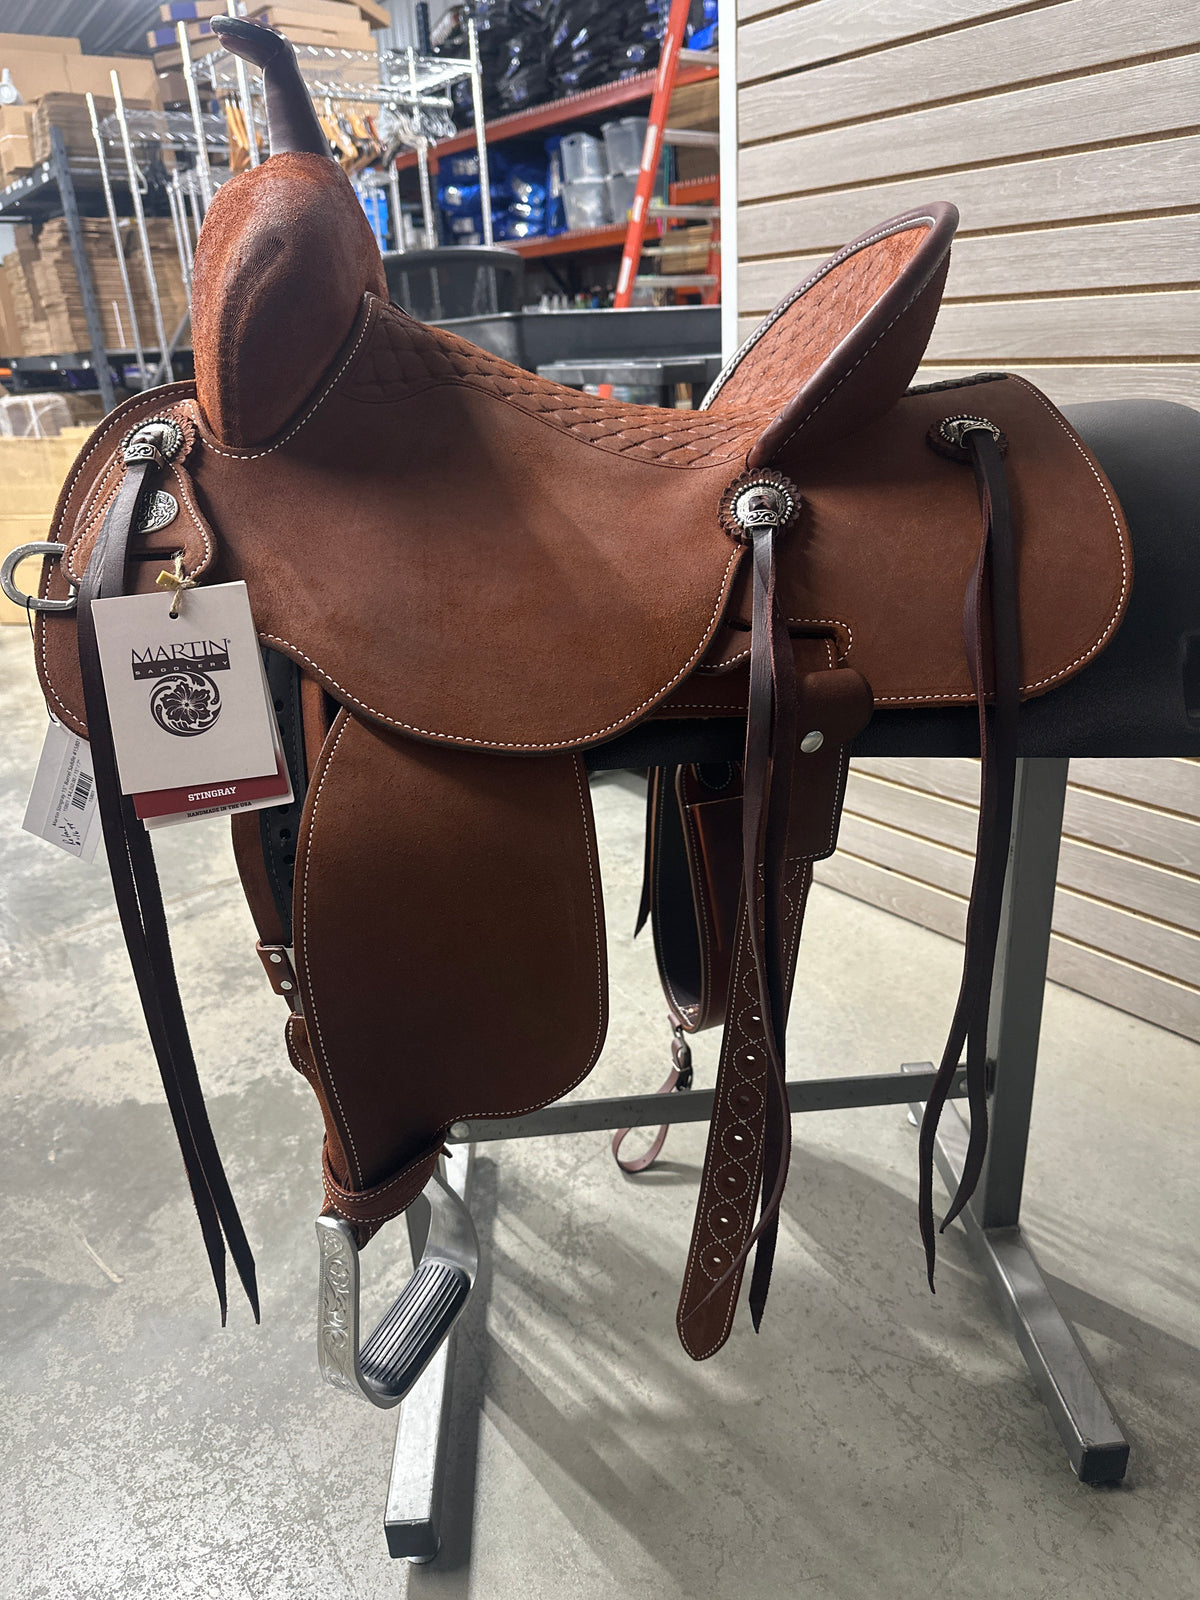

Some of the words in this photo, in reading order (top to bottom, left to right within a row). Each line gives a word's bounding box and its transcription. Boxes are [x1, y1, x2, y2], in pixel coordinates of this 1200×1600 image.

[131, 638, 229, 664] MARTIN
[134, 660, 229, 676] SADDLERY
[187, 786, 237, 802] STINGRAY
[187, 807, 220, 818] HANDMADE
